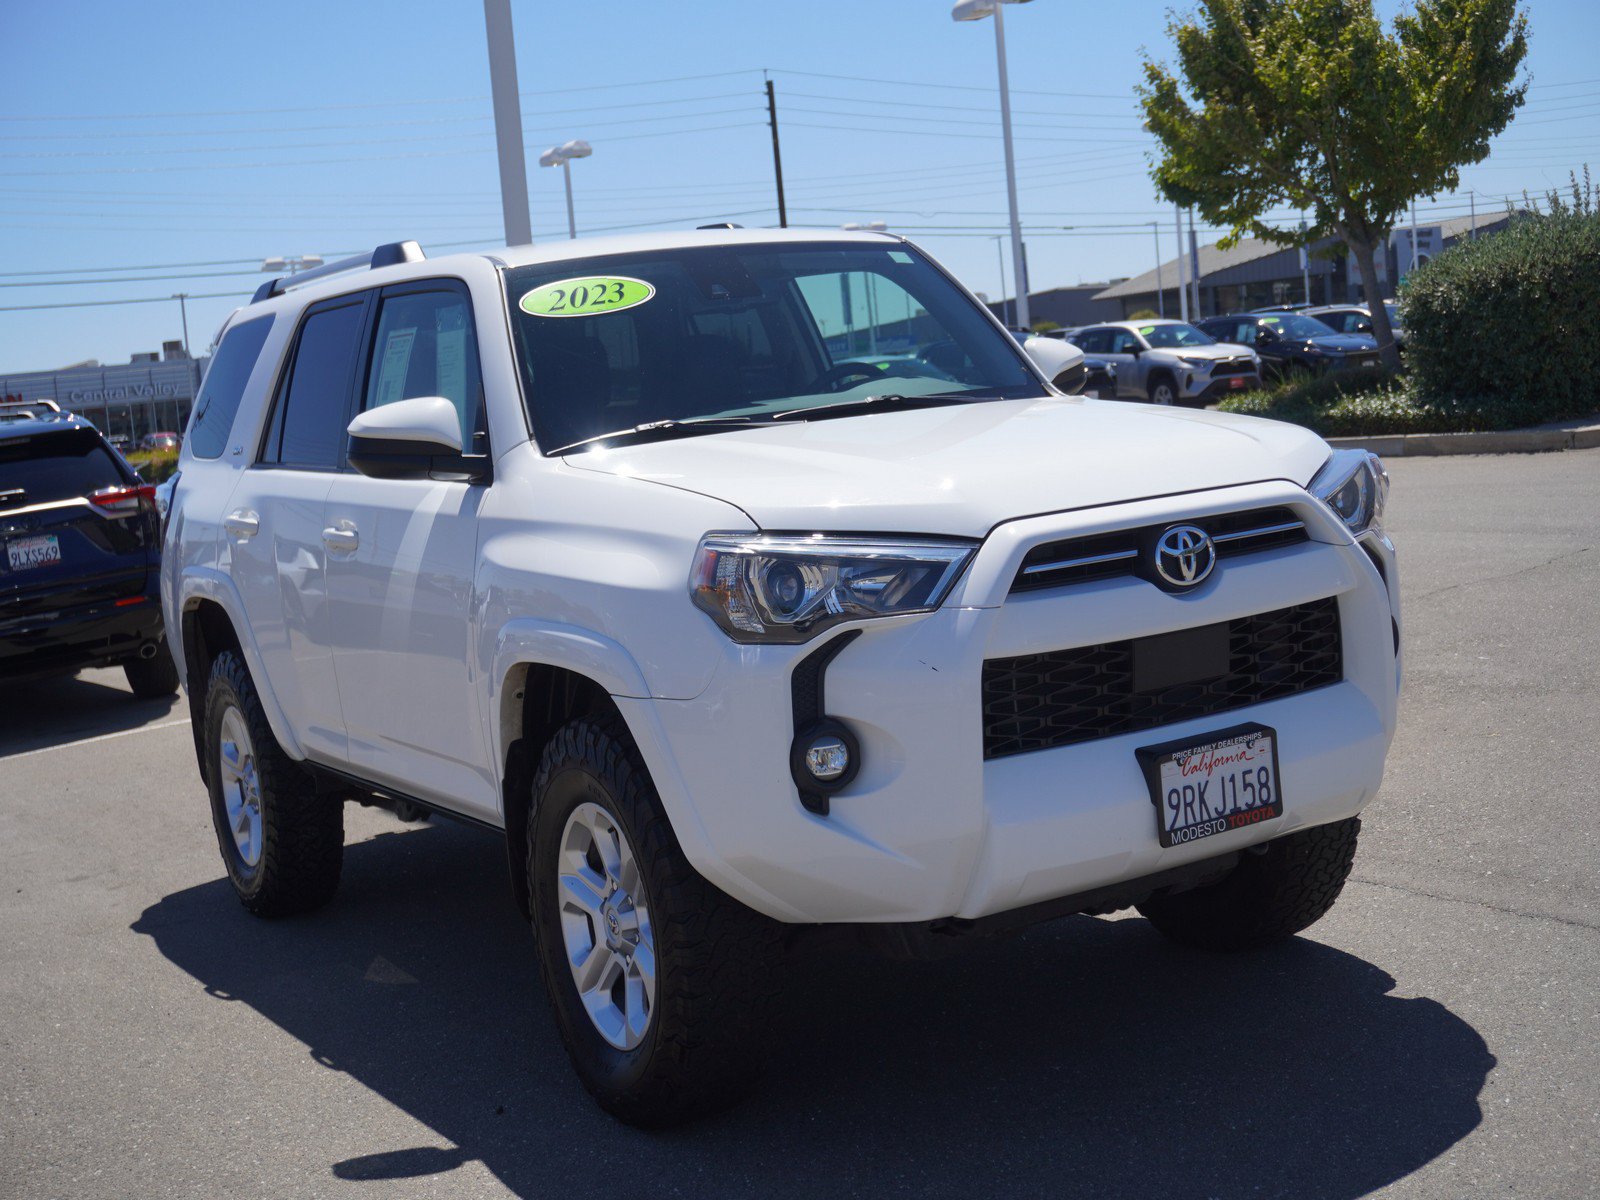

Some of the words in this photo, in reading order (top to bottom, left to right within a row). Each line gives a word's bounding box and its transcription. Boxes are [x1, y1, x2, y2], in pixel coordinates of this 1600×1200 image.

[549, 282, 625, 312] 2023
[70, 385, 129, 403] Central
[133, 382, 180, 398] Valley
[11, 545, 58, 567] 9LXS569
[1172, 750, 1192, 761] PRICE
[1193, 742, 1217, 755] FAMILY
[1217, 732, 1262, 749] DEALERSHIPS
[1181, 750, 1254, 777] California
[1167, 766, 1272, 830] 9RKJ158
[1171, 819, 1226, 845] MODESTO
[1228, 806, 1276, 829] TOYOTA
